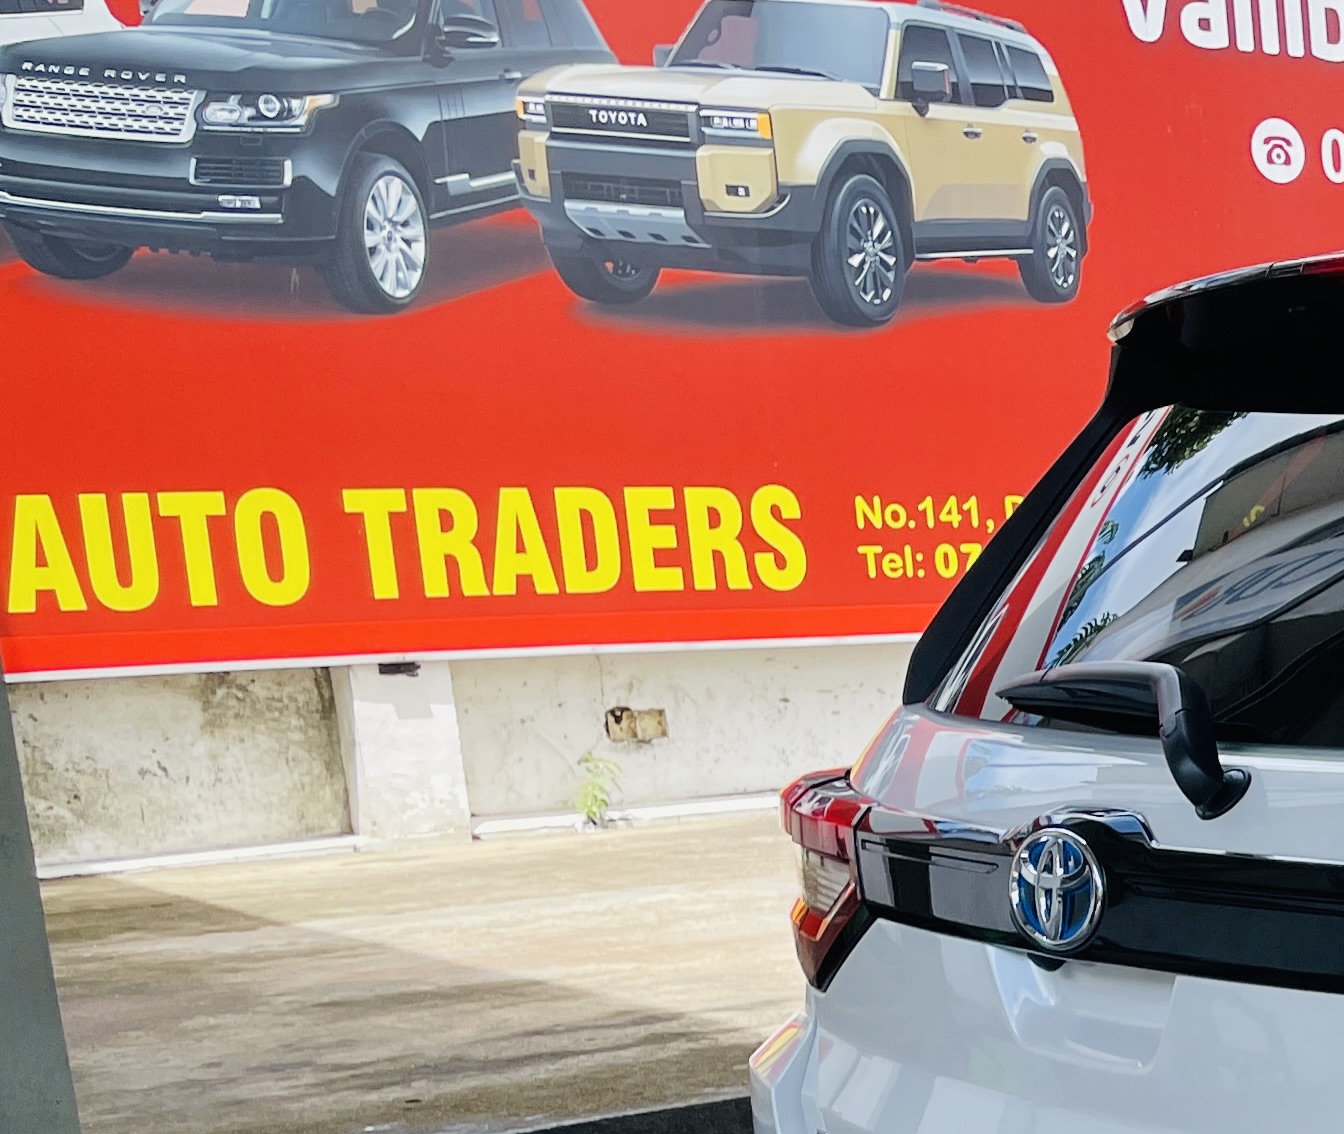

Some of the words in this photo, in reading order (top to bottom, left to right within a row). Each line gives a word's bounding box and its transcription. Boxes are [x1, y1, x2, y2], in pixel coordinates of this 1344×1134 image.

[21, 61, 91, 76] RANGE
[103, 68, 188, 84] ROVER
[588, 109, 648, 127] TOYOTA
[8, 488, 312, 613] AUTO
[342, 484, 807, 601] TRADERS
[857, 544, 926, 579] Tel:
